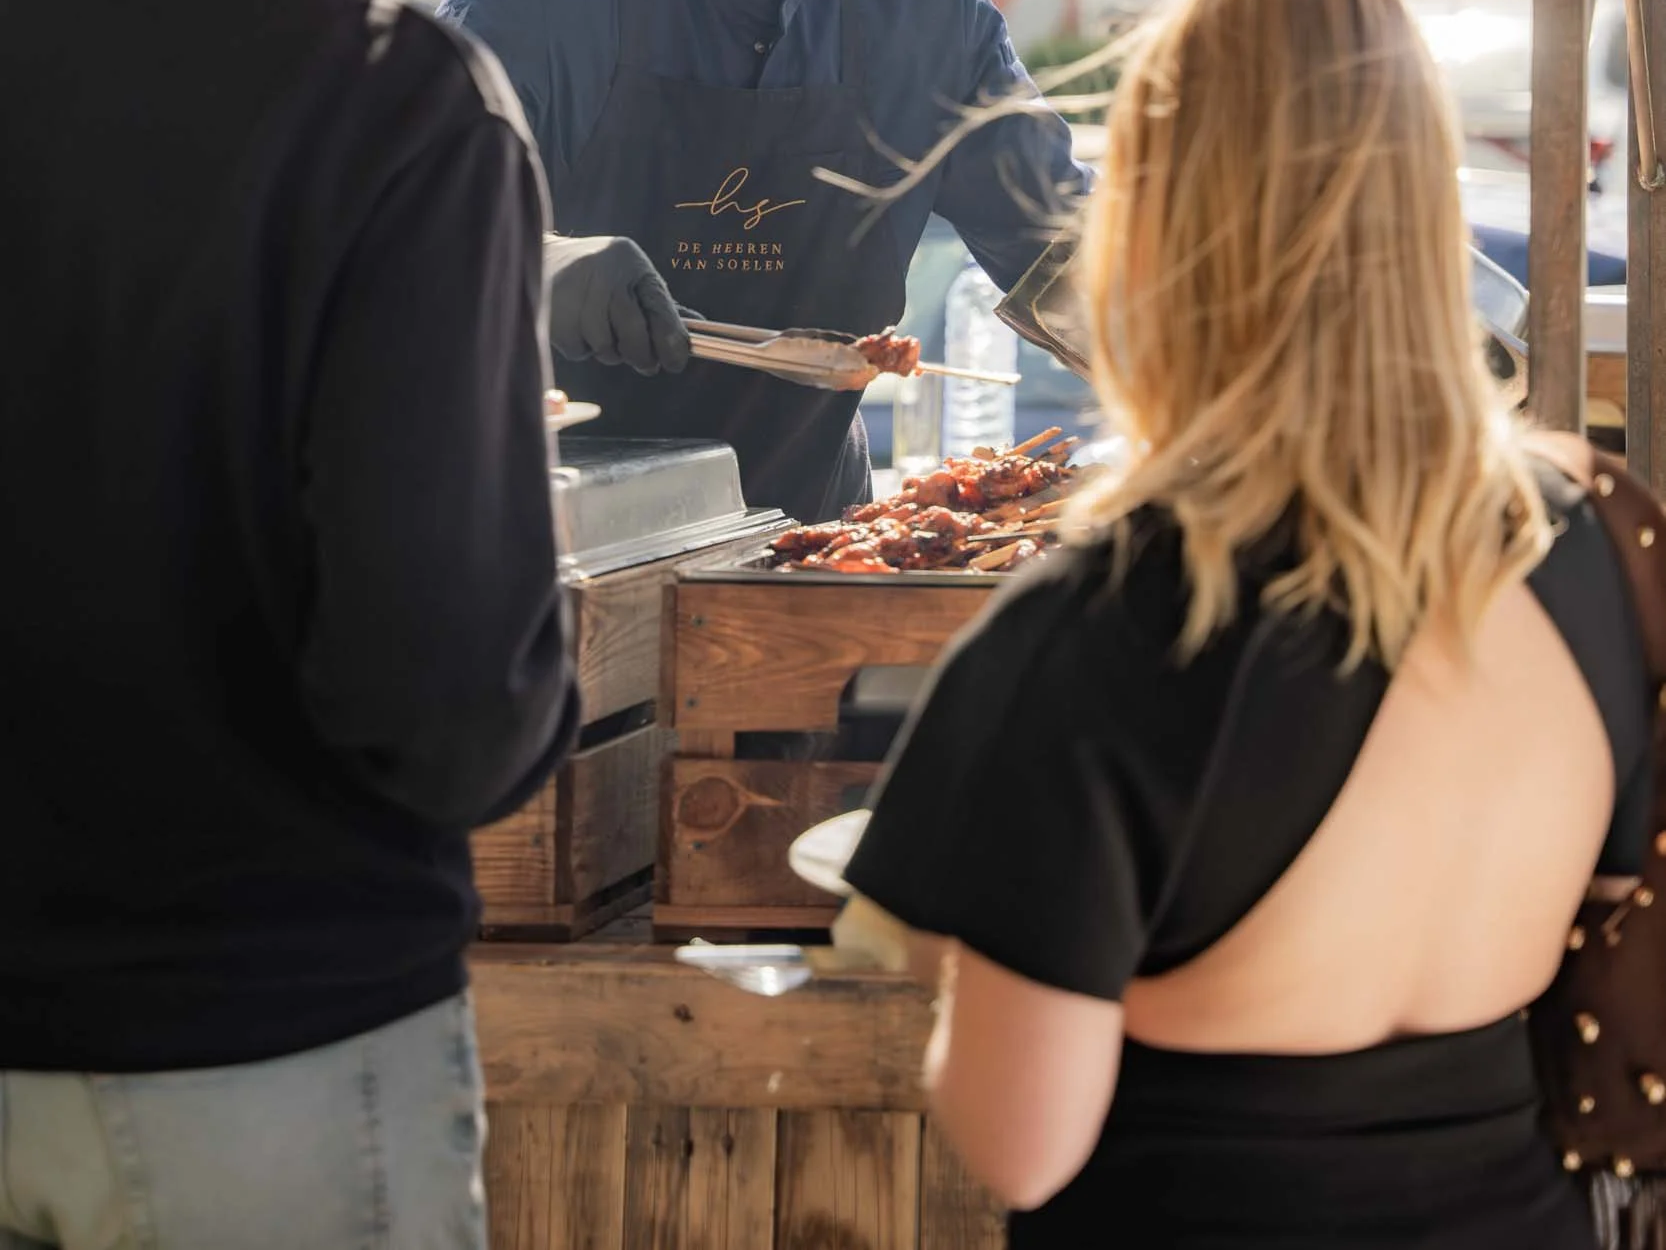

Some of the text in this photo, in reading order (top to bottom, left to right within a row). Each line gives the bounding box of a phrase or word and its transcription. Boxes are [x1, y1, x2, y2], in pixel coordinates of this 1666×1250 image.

[678, 241, 783, 255] DE HEEREN
[671, 258, 784, 271] VAN SOELEN
